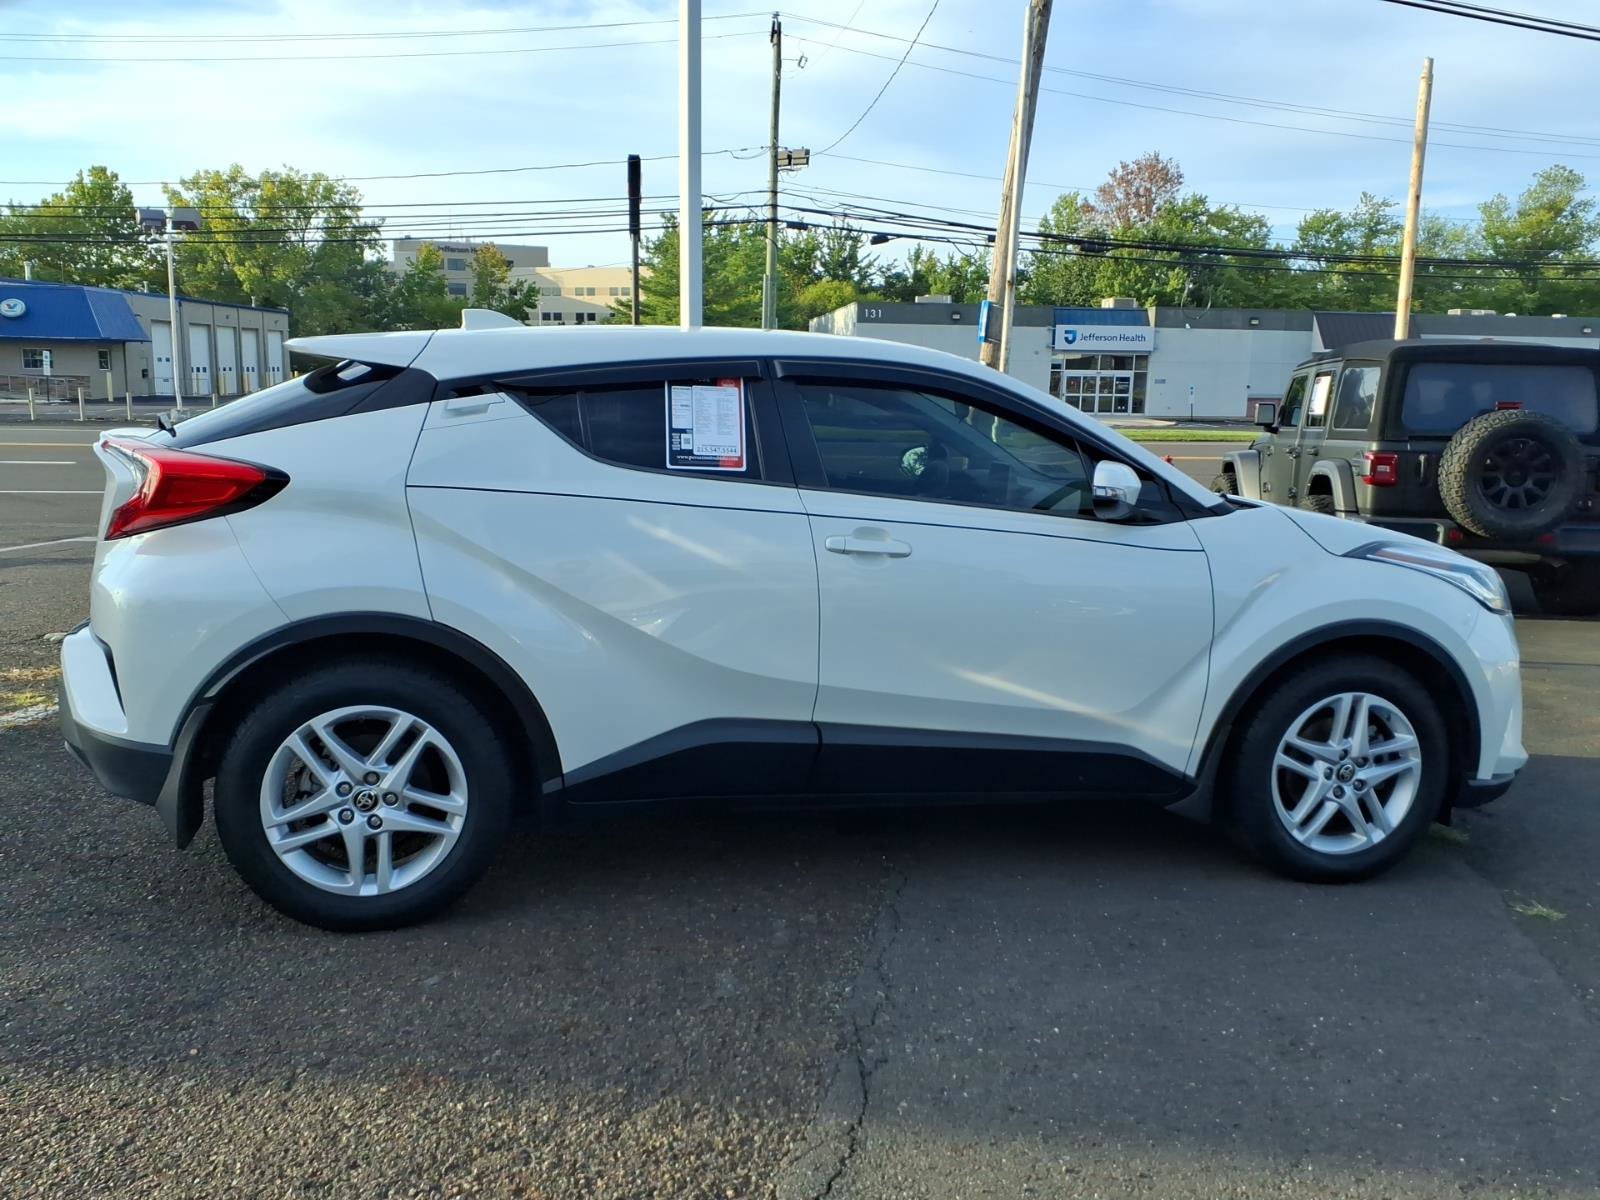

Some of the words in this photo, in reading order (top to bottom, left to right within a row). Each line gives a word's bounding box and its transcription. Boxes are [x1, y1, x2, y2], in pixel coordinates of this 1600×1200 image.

[865, 309, 882, 318] 131
[1080, 333, 1118, 342] Jefferson
[1119, 333, 1146, 342] Health
